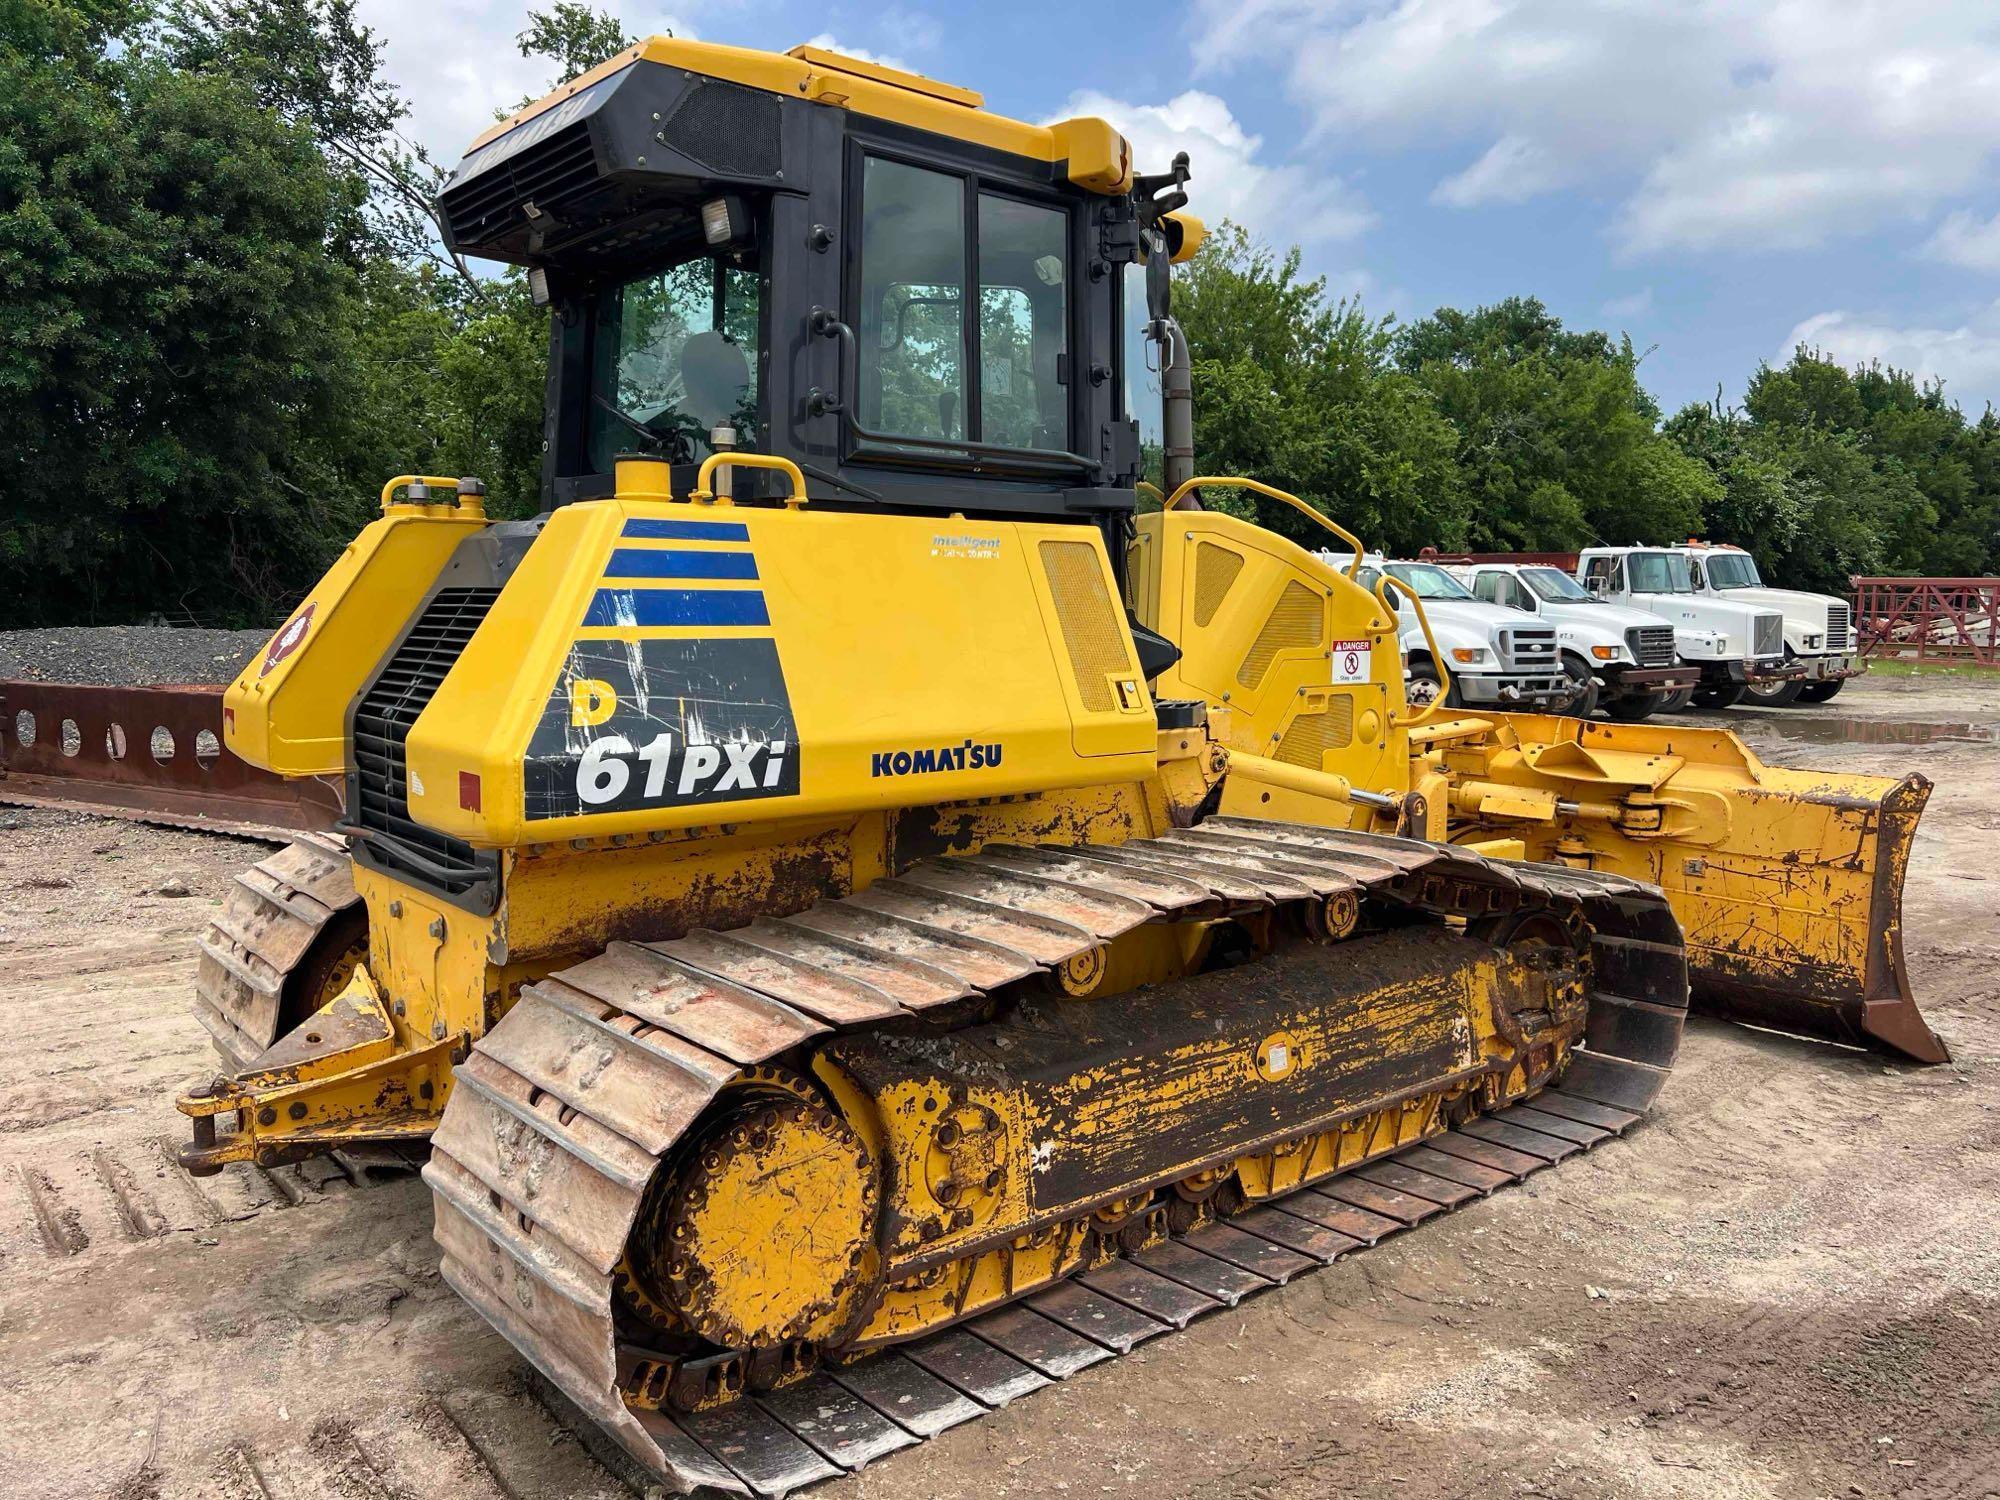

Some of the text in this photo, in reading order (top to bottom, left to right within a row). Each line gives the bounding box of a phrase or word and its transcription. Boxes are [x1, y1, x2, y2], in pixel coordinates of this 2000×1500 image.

[1342, 641, 1369, 651] DANGER
[572, 679, 617, 727] D
[871, 739, 1002, 777] KOMATSU
